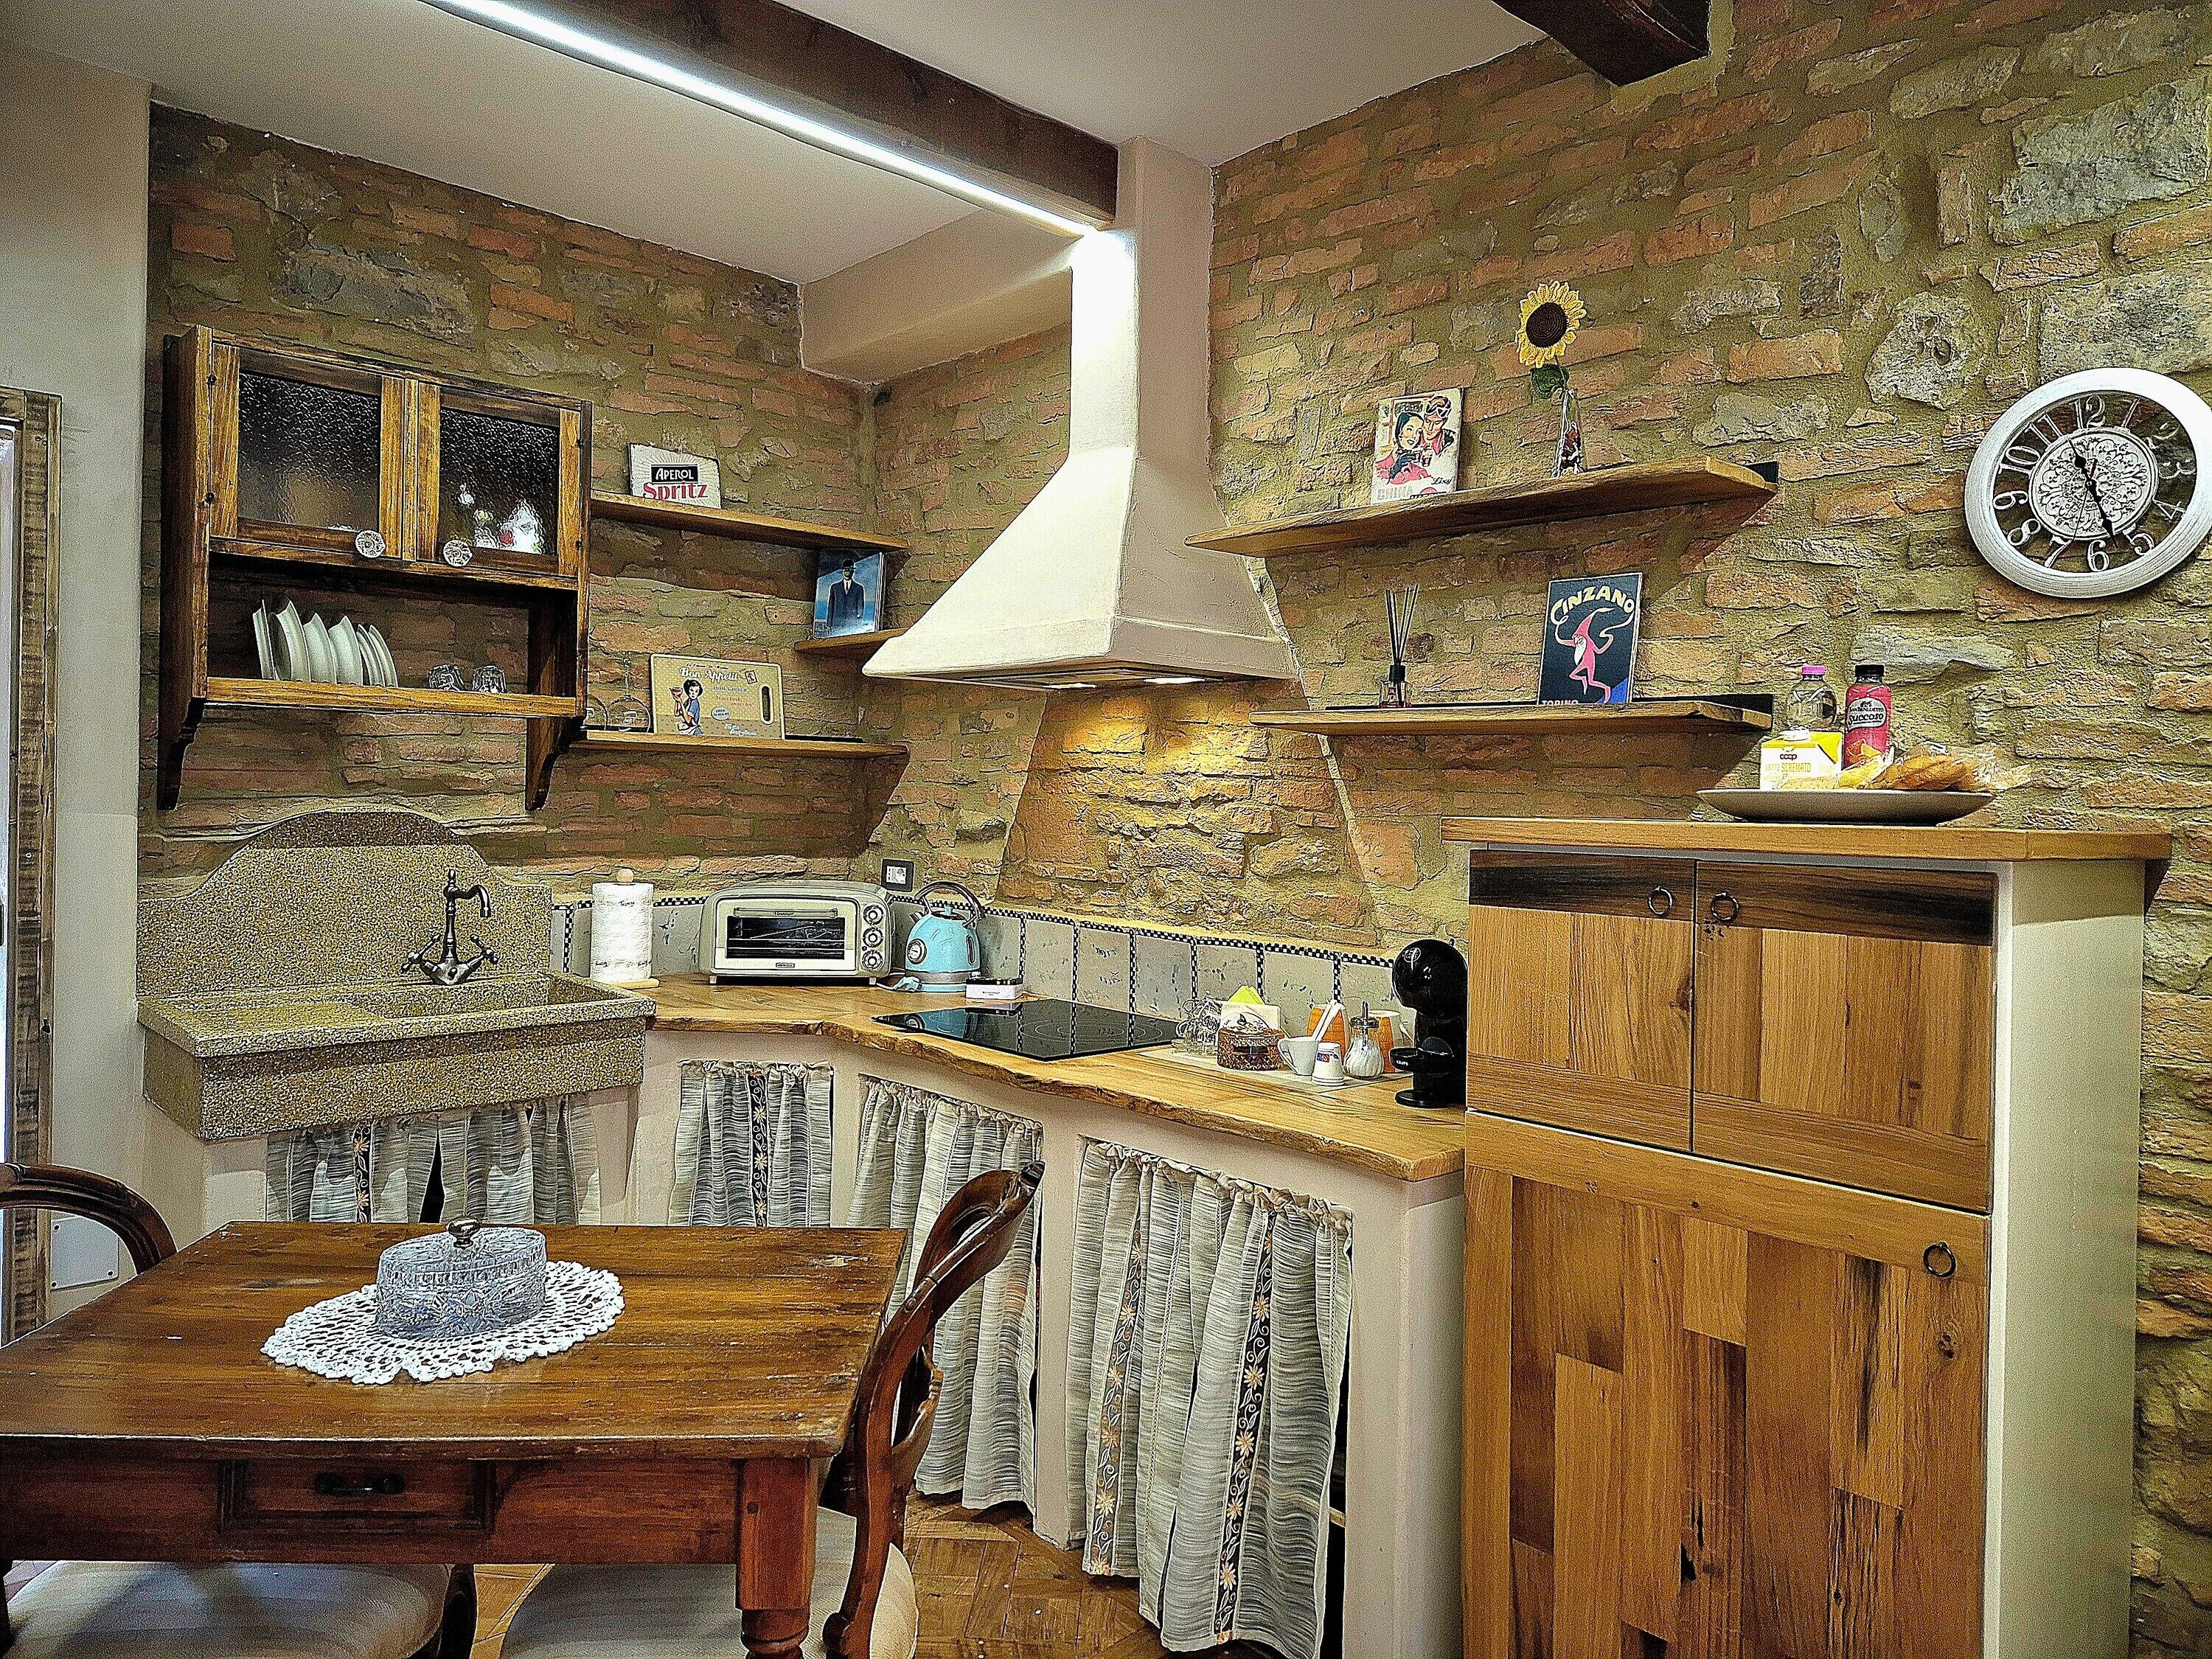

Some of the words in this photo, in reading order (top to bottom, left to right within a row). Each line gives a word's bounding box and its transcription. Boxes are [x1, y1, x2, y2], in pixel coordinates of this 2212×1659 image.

[2067, 394, 2107, 429] 12
[2024, 413, 2062, 445] 11
[655, 467, 695, 481] APEROL
[1997, 445, 2042, 478] 10
[643, 481, 708, 501] Spritz
[1377, 486, 1413, 501] CHINA
[1992, 490, 2029, 510] 9
[2153, 500, 2187, 521] 4
[2006, 518, 2042, 546] 8
[2123, 524, 2155, 556] 5
[2044, 535, 2073, 568] 7
[2087, 538, 2110, 573] 6
[1550, 585, 1635, 625] CINZANO
[680, 667, 700, 678] Bon
[705, 669, 738, 683] Appetit
[1848, 713, 1884, 725] SUCCOSO
